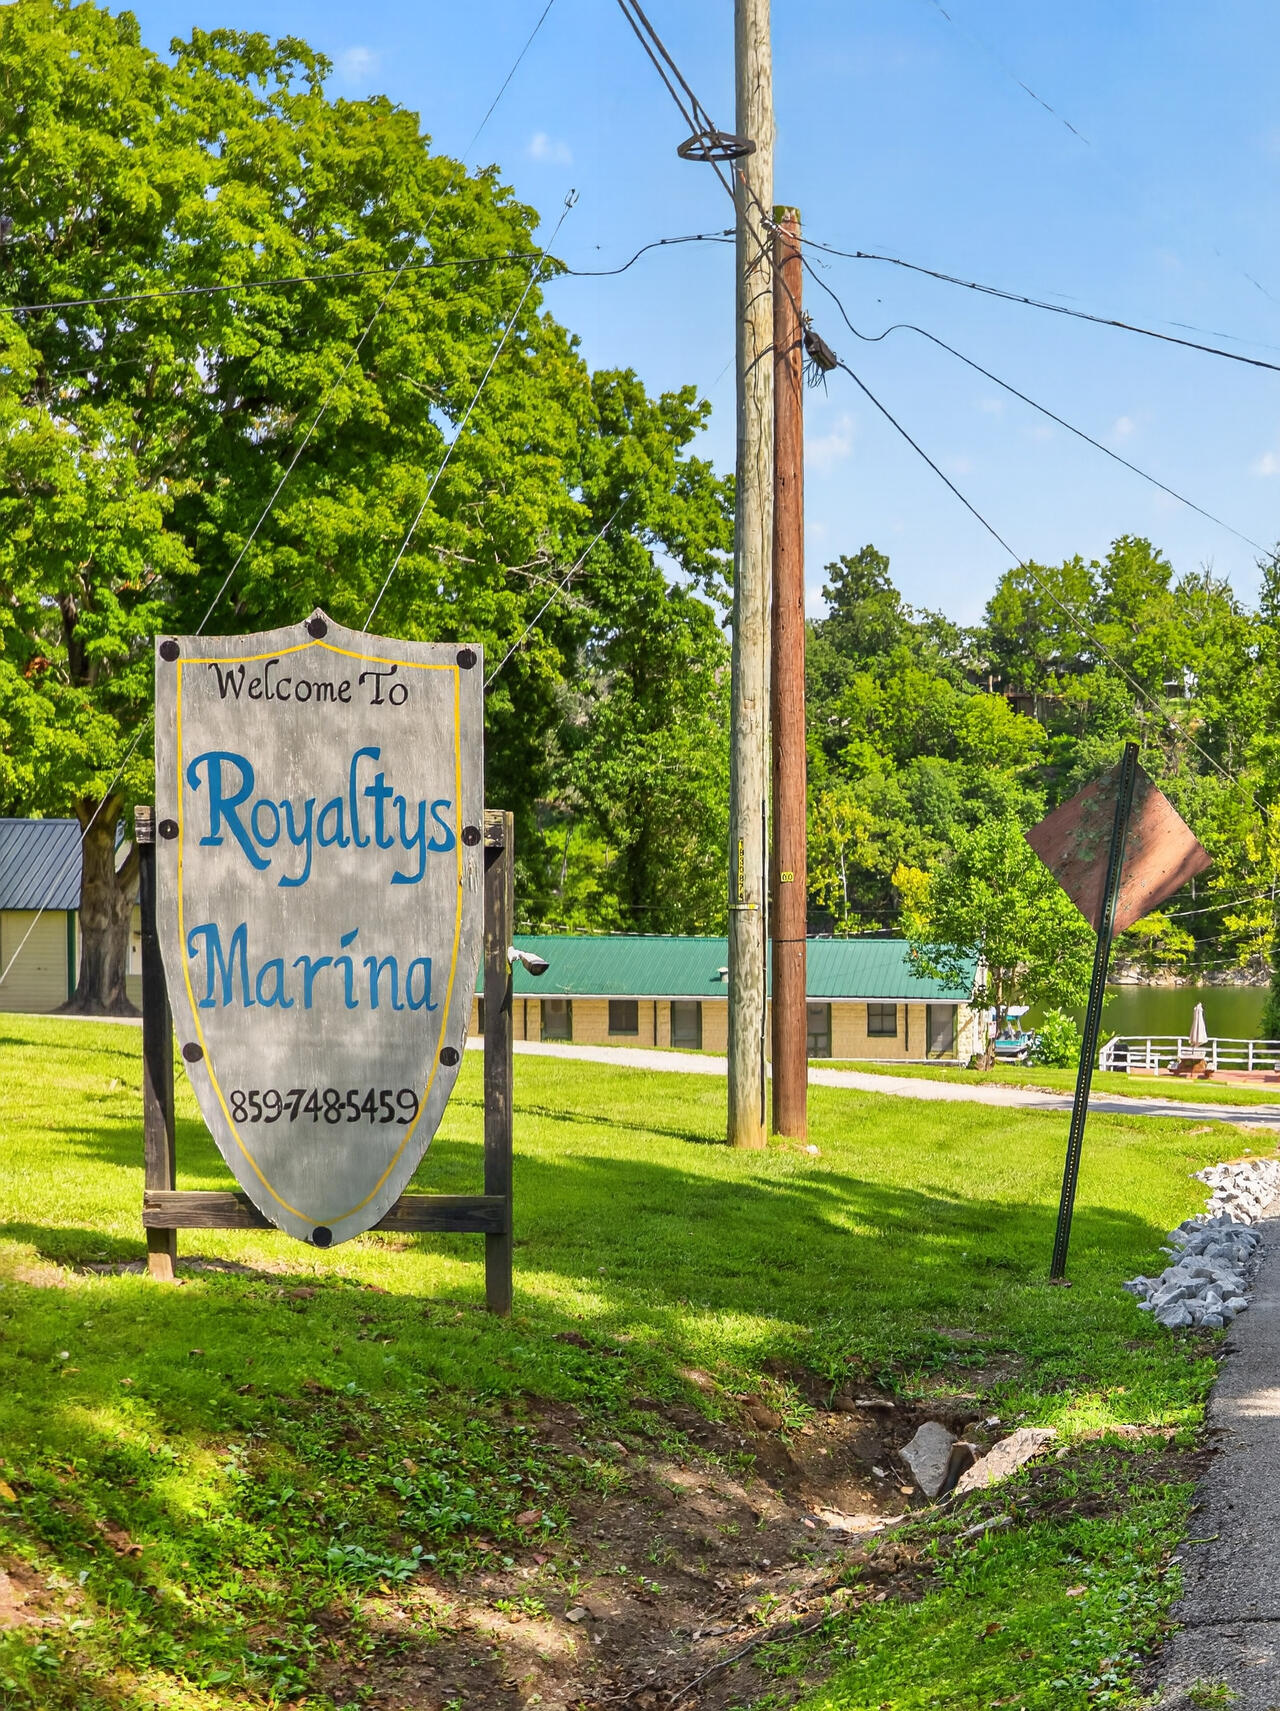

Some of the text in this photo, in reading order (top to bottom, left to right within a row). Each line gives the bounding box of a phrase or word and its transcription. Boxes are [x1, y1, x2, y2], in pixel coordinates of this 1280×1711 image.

[208, 659, 409, 706] Welcome To
[187, 747, 456, 887] Royaltys
[187, 922, 438, 1011] Marina
[231, 1088, 419, 1126] 859-748-5459
